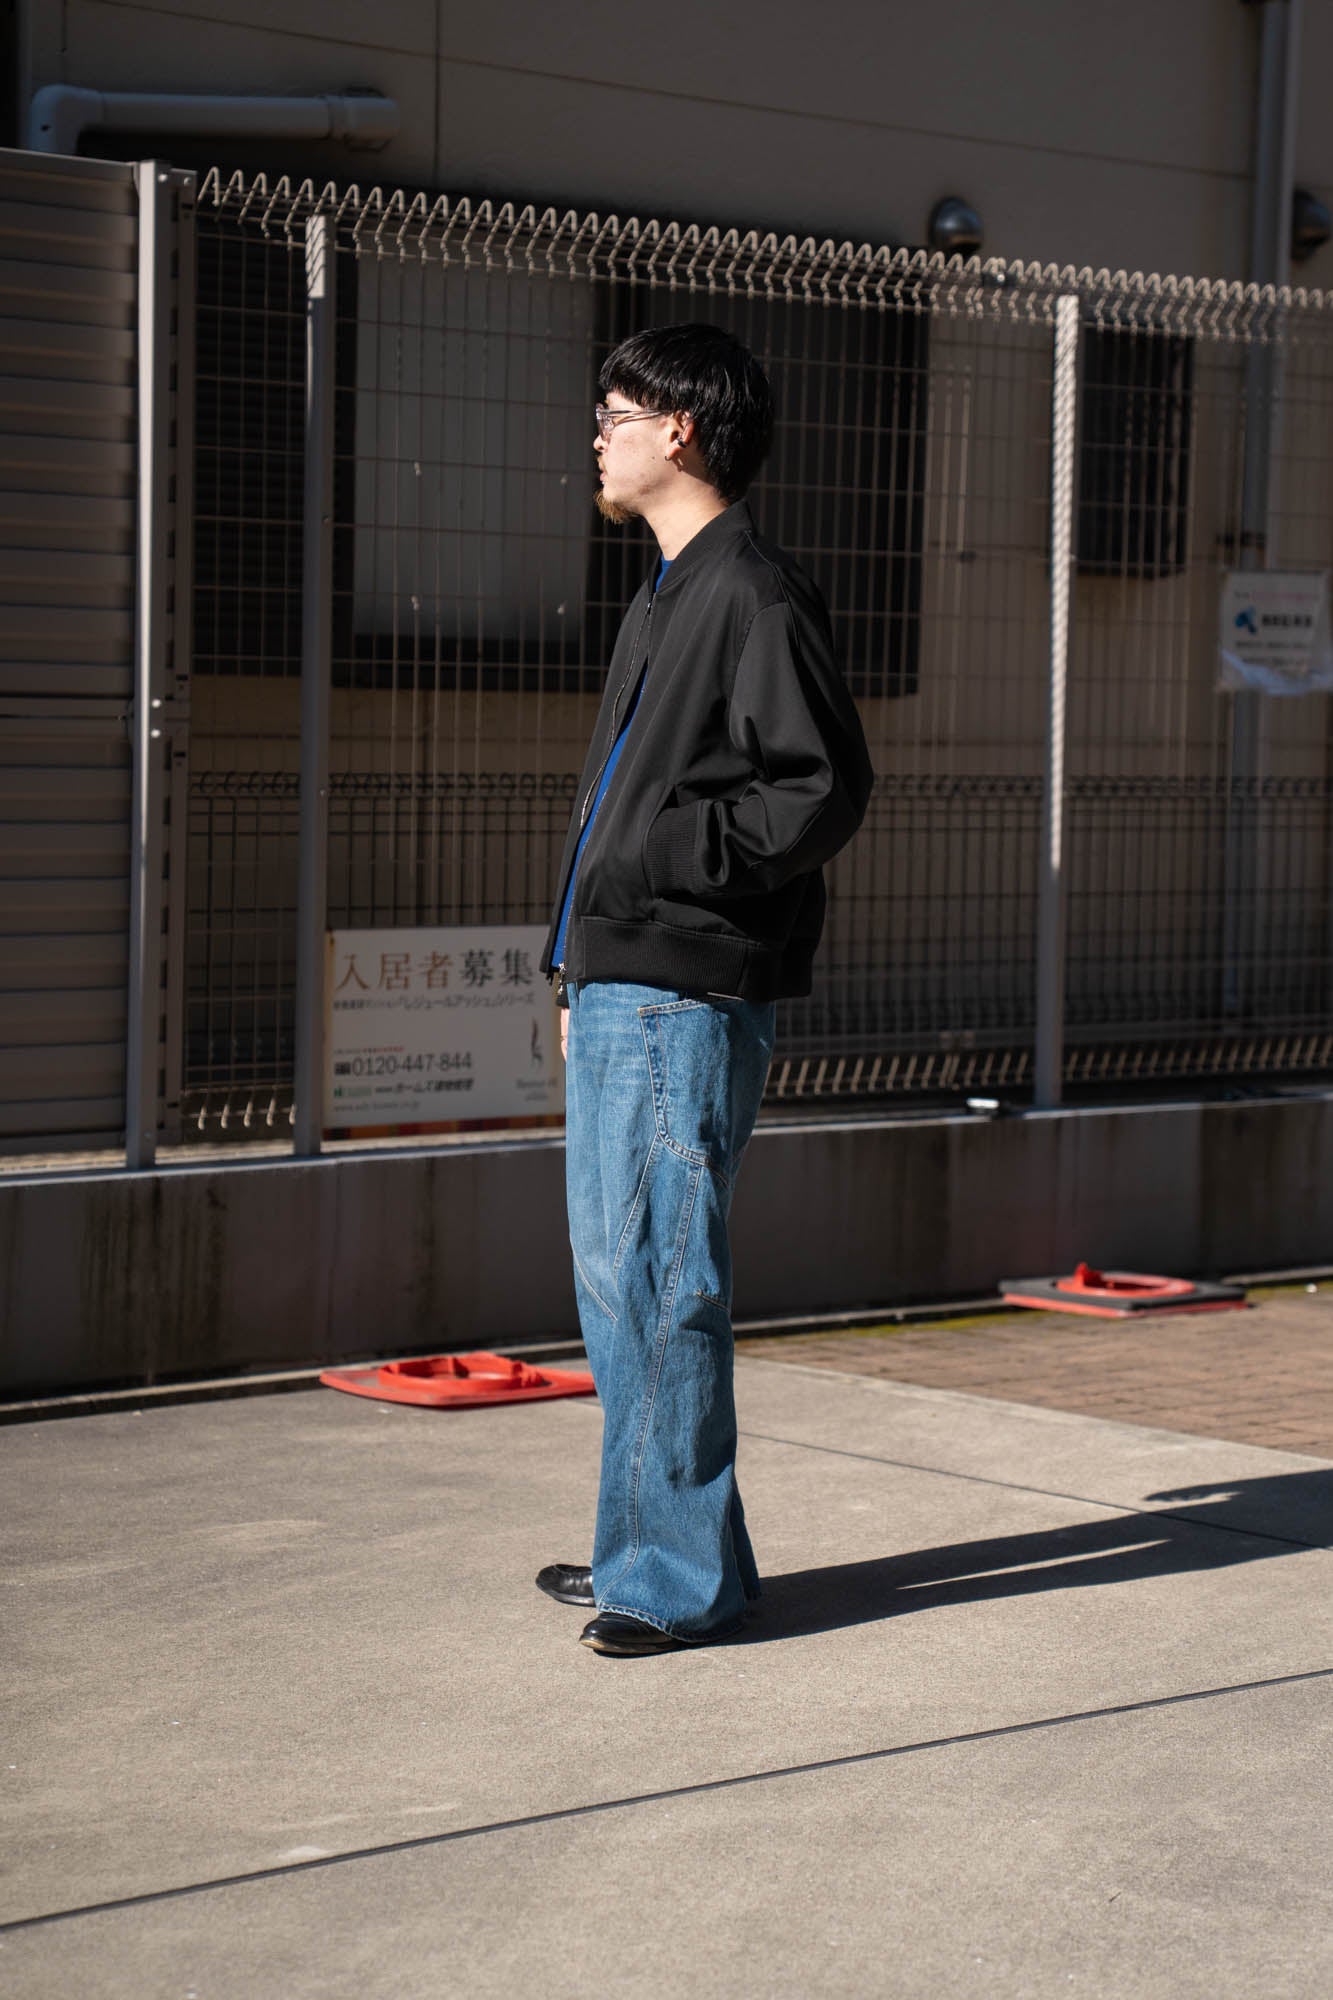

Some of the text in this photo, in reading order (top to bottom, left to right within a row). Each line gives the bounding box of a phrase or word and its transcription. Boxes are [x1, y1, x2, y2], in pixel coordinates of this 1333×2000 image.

[336, 948, 534, 991] 入居者募集
[352, 1051, 473, 1077] 0120-447-844
